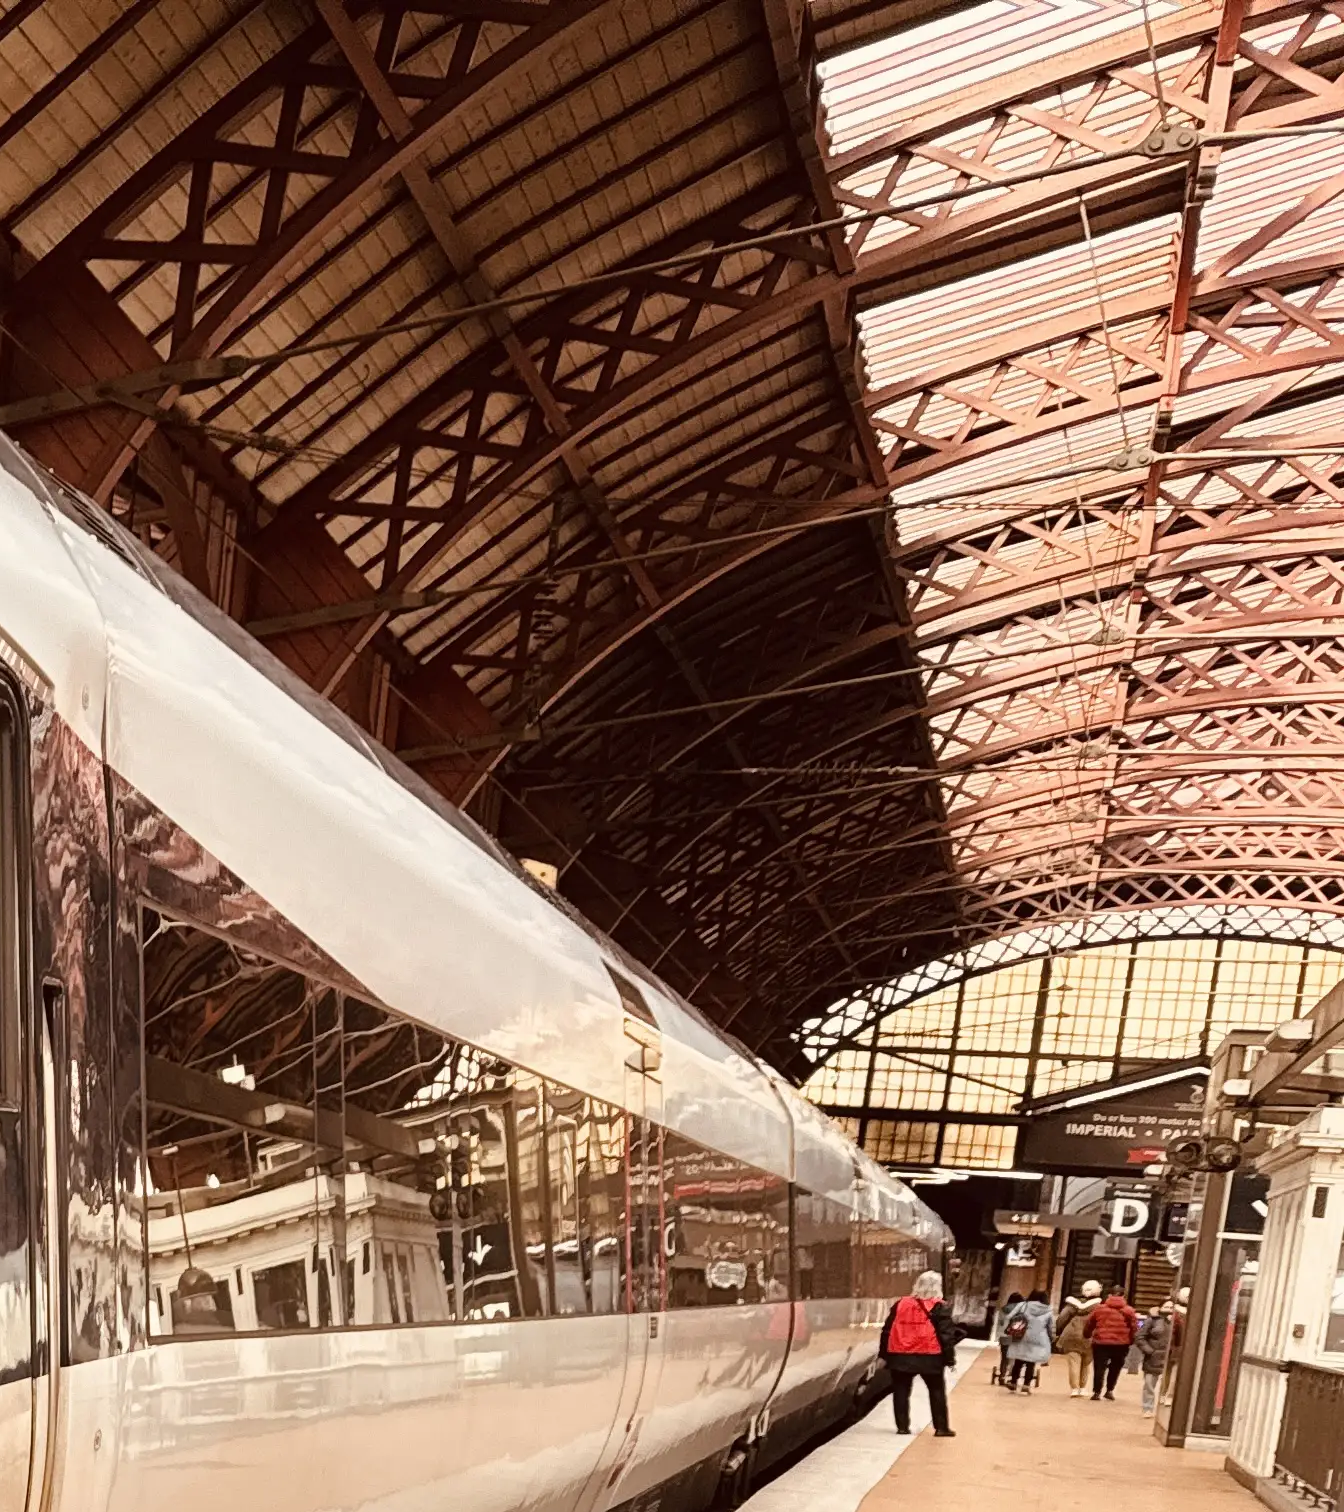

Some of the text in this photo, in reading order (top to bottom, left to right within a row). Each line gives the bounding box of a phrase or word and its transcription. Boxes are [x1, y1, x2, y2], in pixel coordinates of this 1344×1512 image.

[1120, 1114, 1137, 1123] kun
[1066, 1123, 1137, 1138] IMPERIAL
[1110, 1198, 1149, 1234] D
